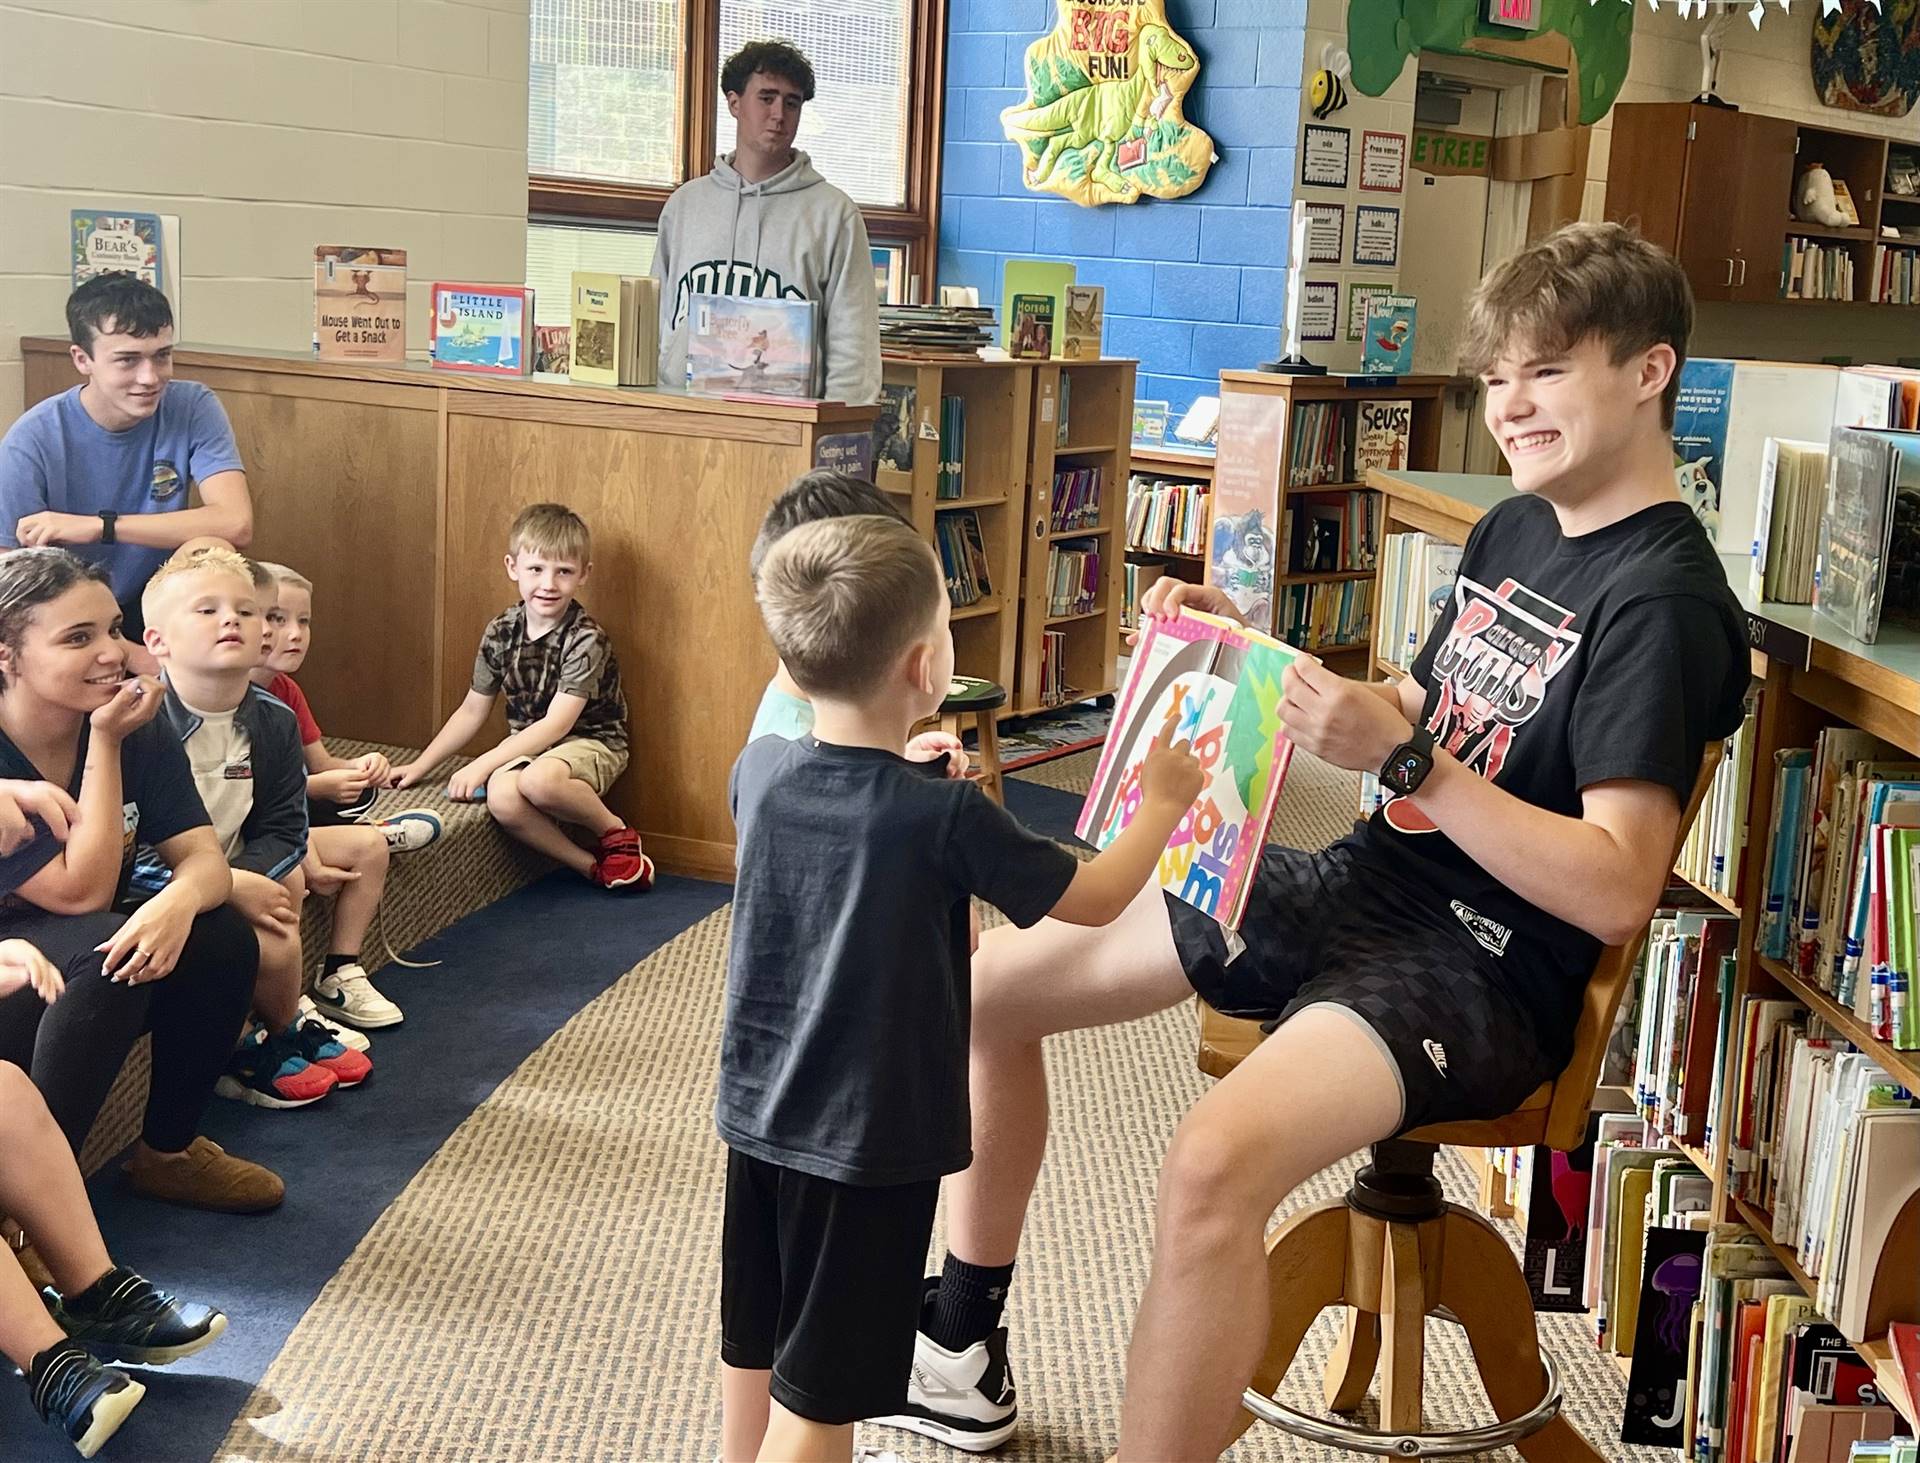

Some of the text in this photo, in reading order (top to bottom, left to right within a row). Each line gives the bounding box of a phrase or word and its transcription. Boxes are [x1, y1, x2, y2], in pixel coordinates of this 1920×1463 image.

[1071, 9, 1129, 53] BIG
[1089, 56, 1128, 79] FUN!
[95, 237, 138, 253] BEAR'S
[460, 295, 503, 308] LITTLE
[321, 314, 401, 330] Mouse Went Out to
[460, 308, 503, 320] ISLAND
[335, 330, 387, 344] Get a Snack
[1362, 403, 1409, 432] Seuss
[1747, 617, 1768, 647] EASY
[1430, 1043, 1448, 1069] NIKE
[1543, 1248, 1571, 1295] L
[1820, 1337, 1842, 1347] THE
